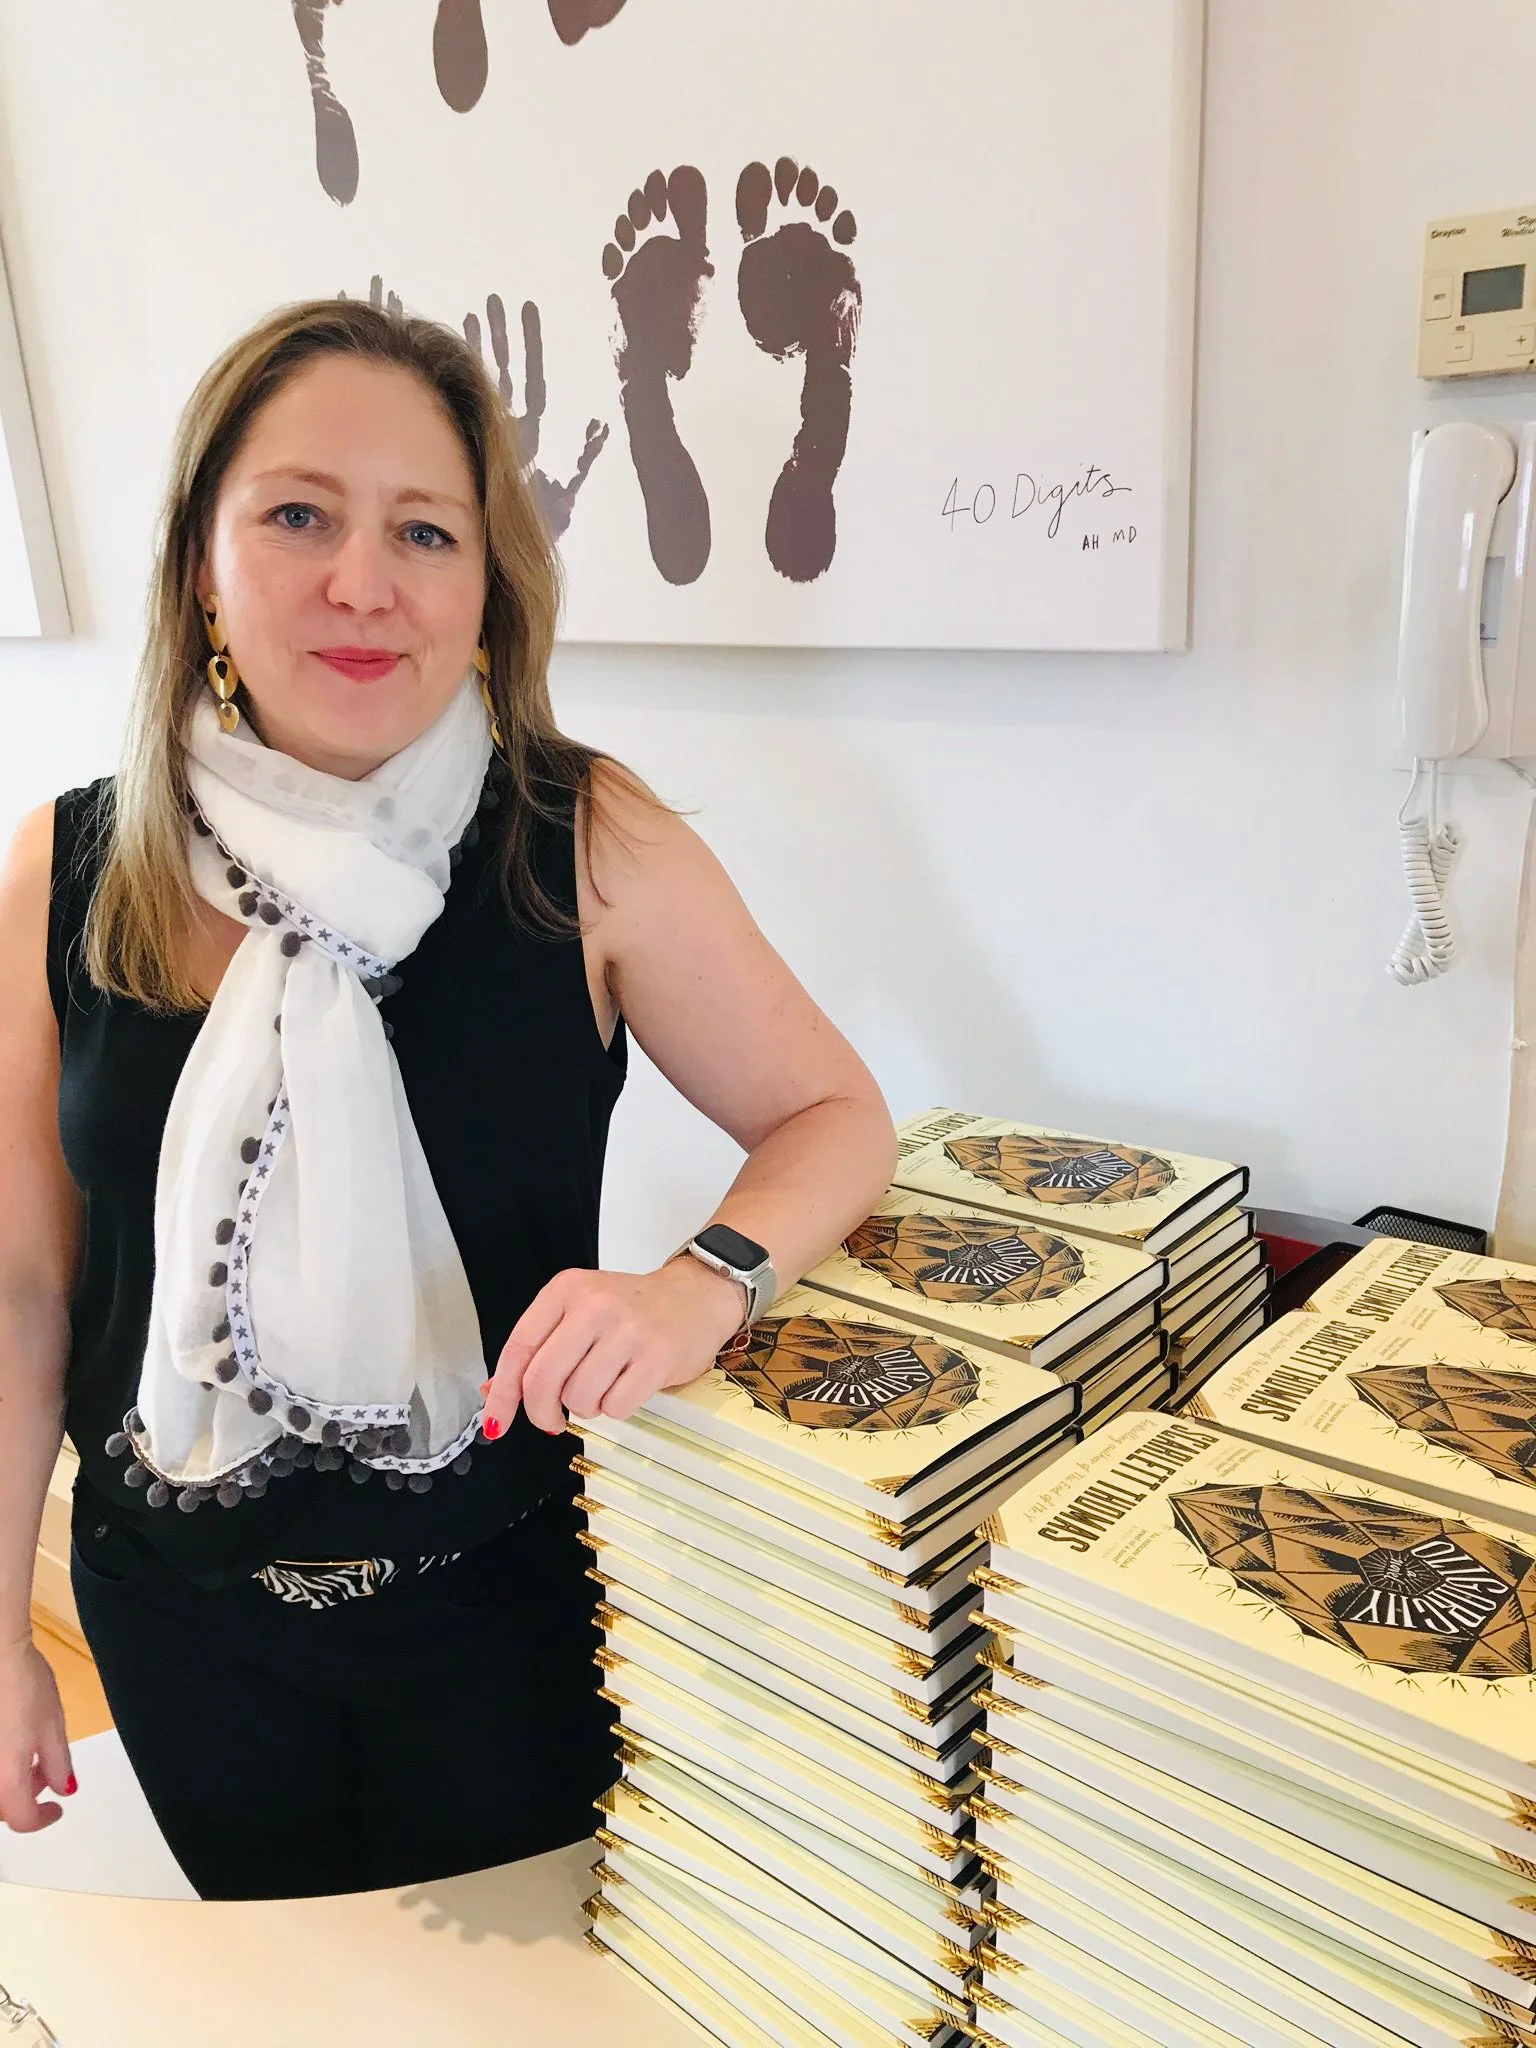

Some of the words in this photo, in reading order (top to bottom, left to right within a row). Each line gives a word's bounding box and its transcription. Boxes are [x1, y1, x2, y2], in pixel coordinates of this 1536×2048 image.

[941, 477, 996, 532] 40
[1011, 463, 1132, 539] Digits
[1082, 533, 1099, 551] AH
[1112, 525, 1137, 544] MD
[1036, 1151, 1136, 1188] OLIGARCHY
[931, 1238, 1041, 1286] OLIGARCHY
[1382, 1244, 1453, 1286] SCARLETT
[1345, 1280, 1417, 1323] THOMAS
[1289, 1320, 1377, 1373] SCARLETT
[796, 1349, 931, 1407] OLIGARCHY
[1240, 1364, 1328, 1422] THOMAS
[1110, 1423, 1221, 1491] SCARLETT
[1037, 1480, 1148, 1553] THOMAS
[1350, 1540, 1509, 1635] OLIGARCHY
